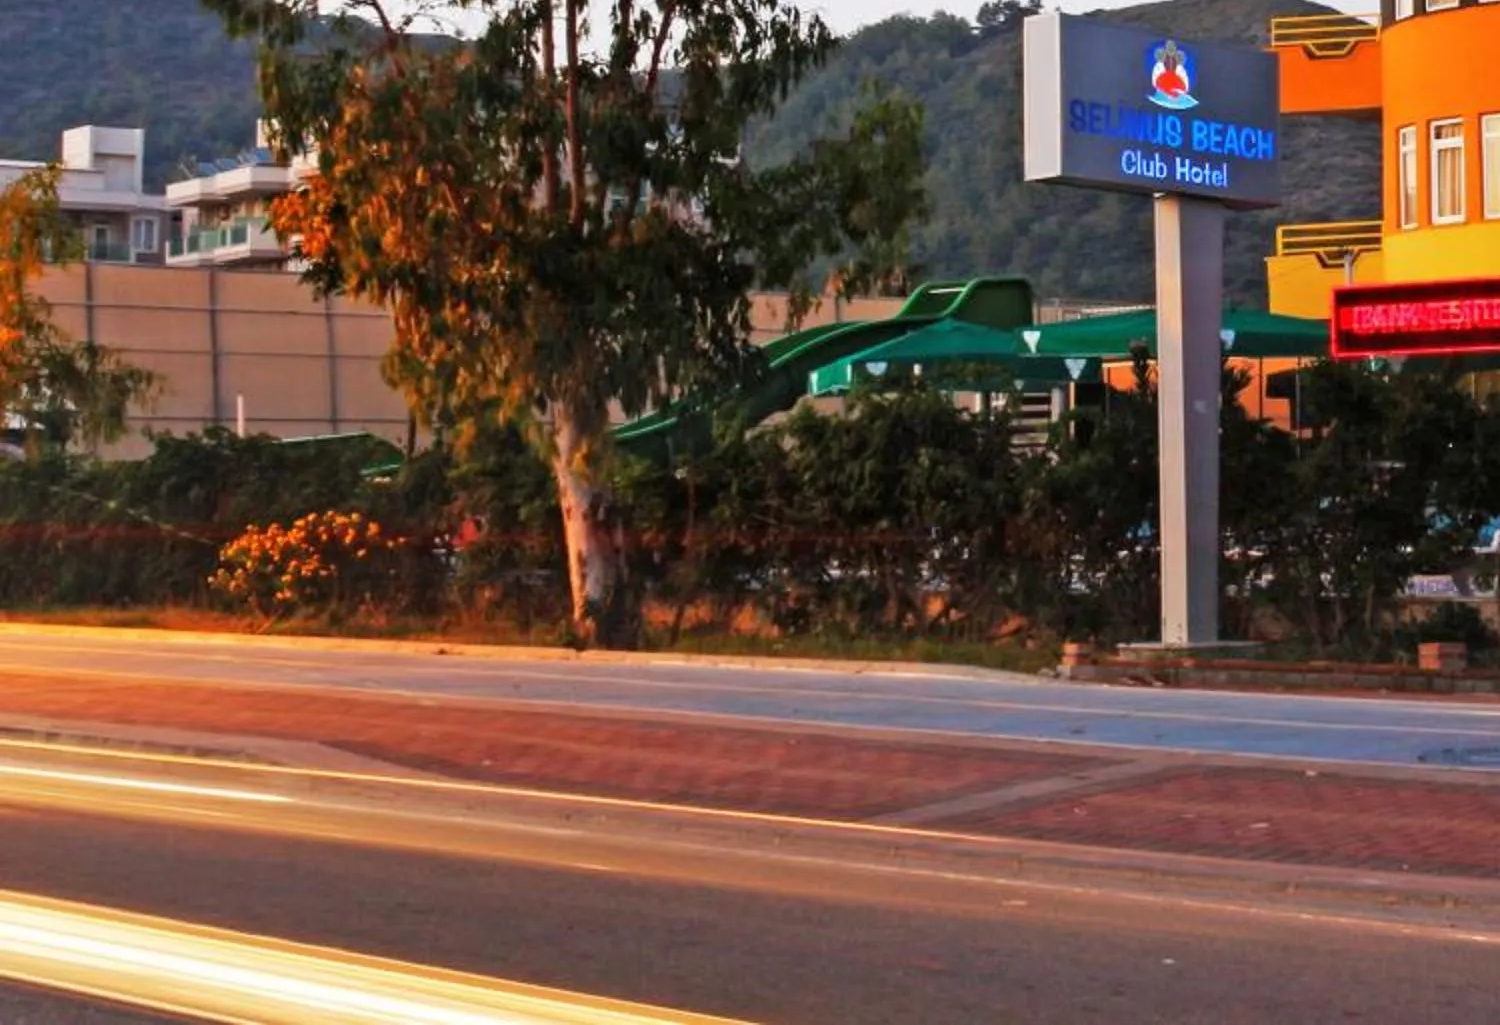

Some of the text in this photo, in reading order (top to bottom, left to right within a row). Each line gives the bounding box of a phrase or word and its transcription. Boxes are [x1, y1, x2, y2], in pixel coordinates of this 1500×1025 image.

[1192, 120, 1274, 159] BEACH
[1121, 150, 1228, 188] Club Hotel
